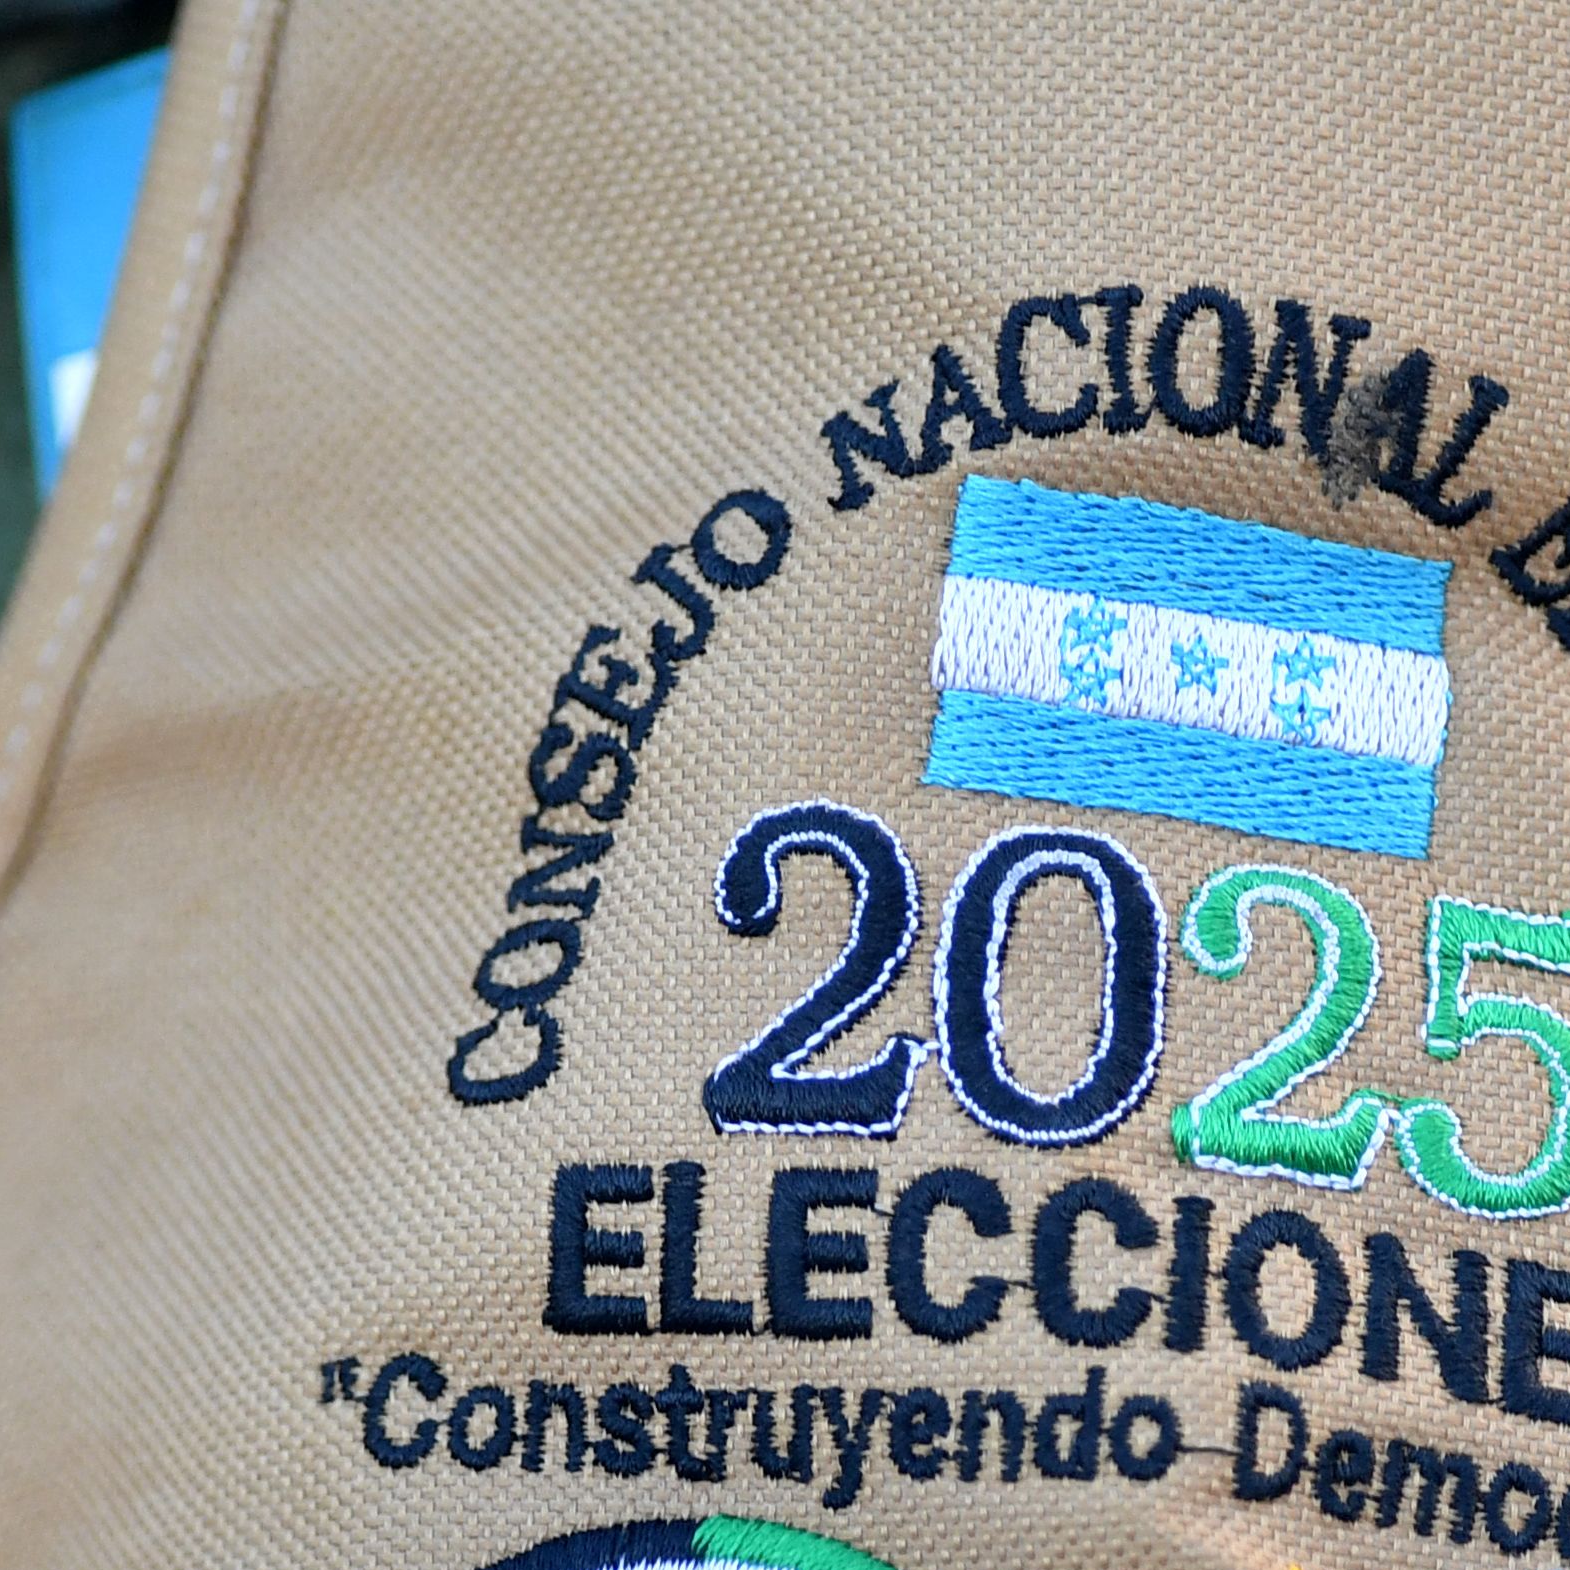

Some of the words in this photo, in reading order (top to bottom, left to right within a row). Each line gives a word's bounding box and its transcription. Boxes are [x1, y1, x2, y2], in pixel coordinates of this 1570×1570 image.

[447, 488, 791, 1106] CONSEJO
[821, 285, 1508, 526] NACIONAL
[318, 1352, 1179, 1508] "Construyendo
